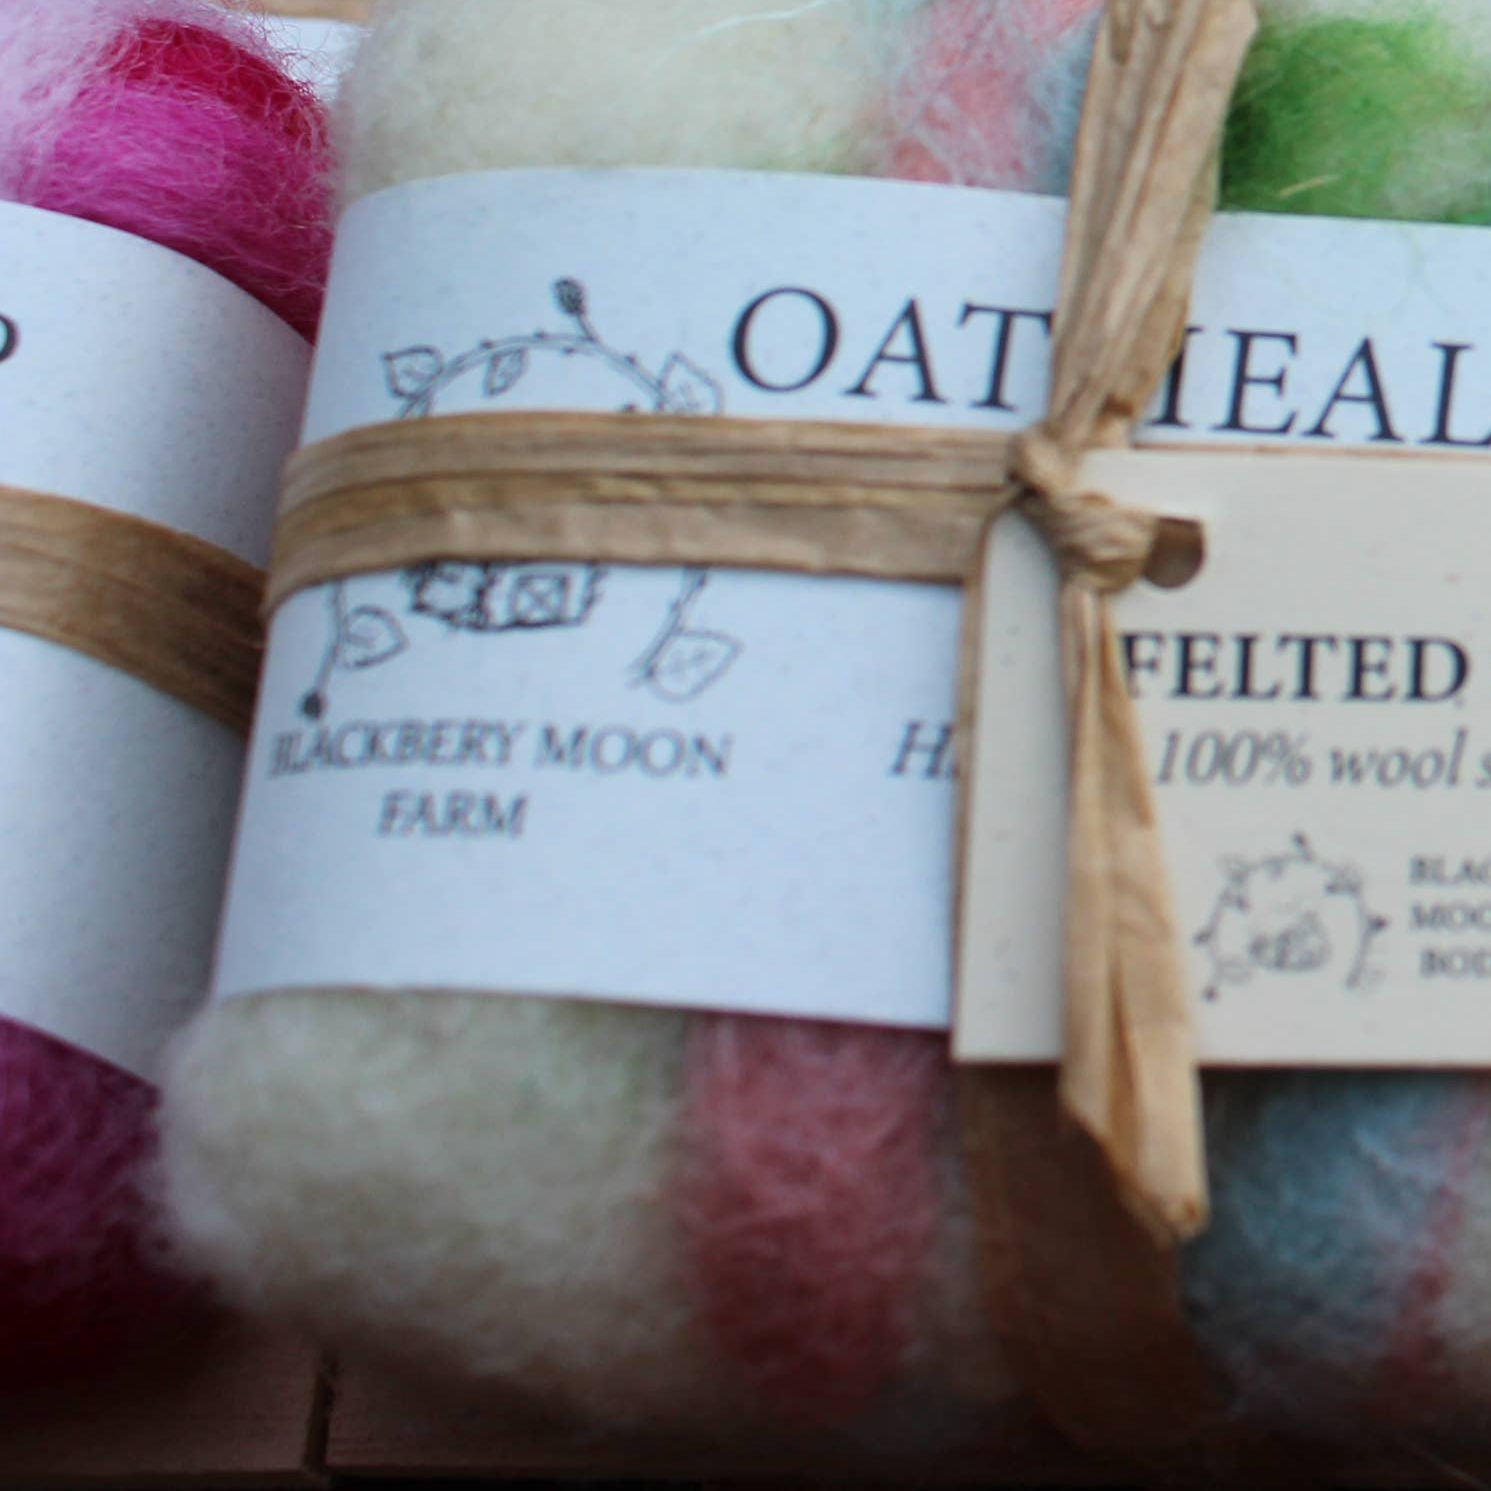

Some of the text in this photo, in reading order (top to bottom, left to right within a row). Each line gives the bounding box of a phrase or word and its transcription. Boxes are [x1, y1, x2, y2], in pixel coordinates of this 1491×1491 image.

[1122, 630, 1469, 704] FELTED
[533, 724, 736, 778] MOON
[1157, 729, 1313, 789] 100%
[1327, 728, 1468, 789] wool
[374, 787, 529, 839] FARM
